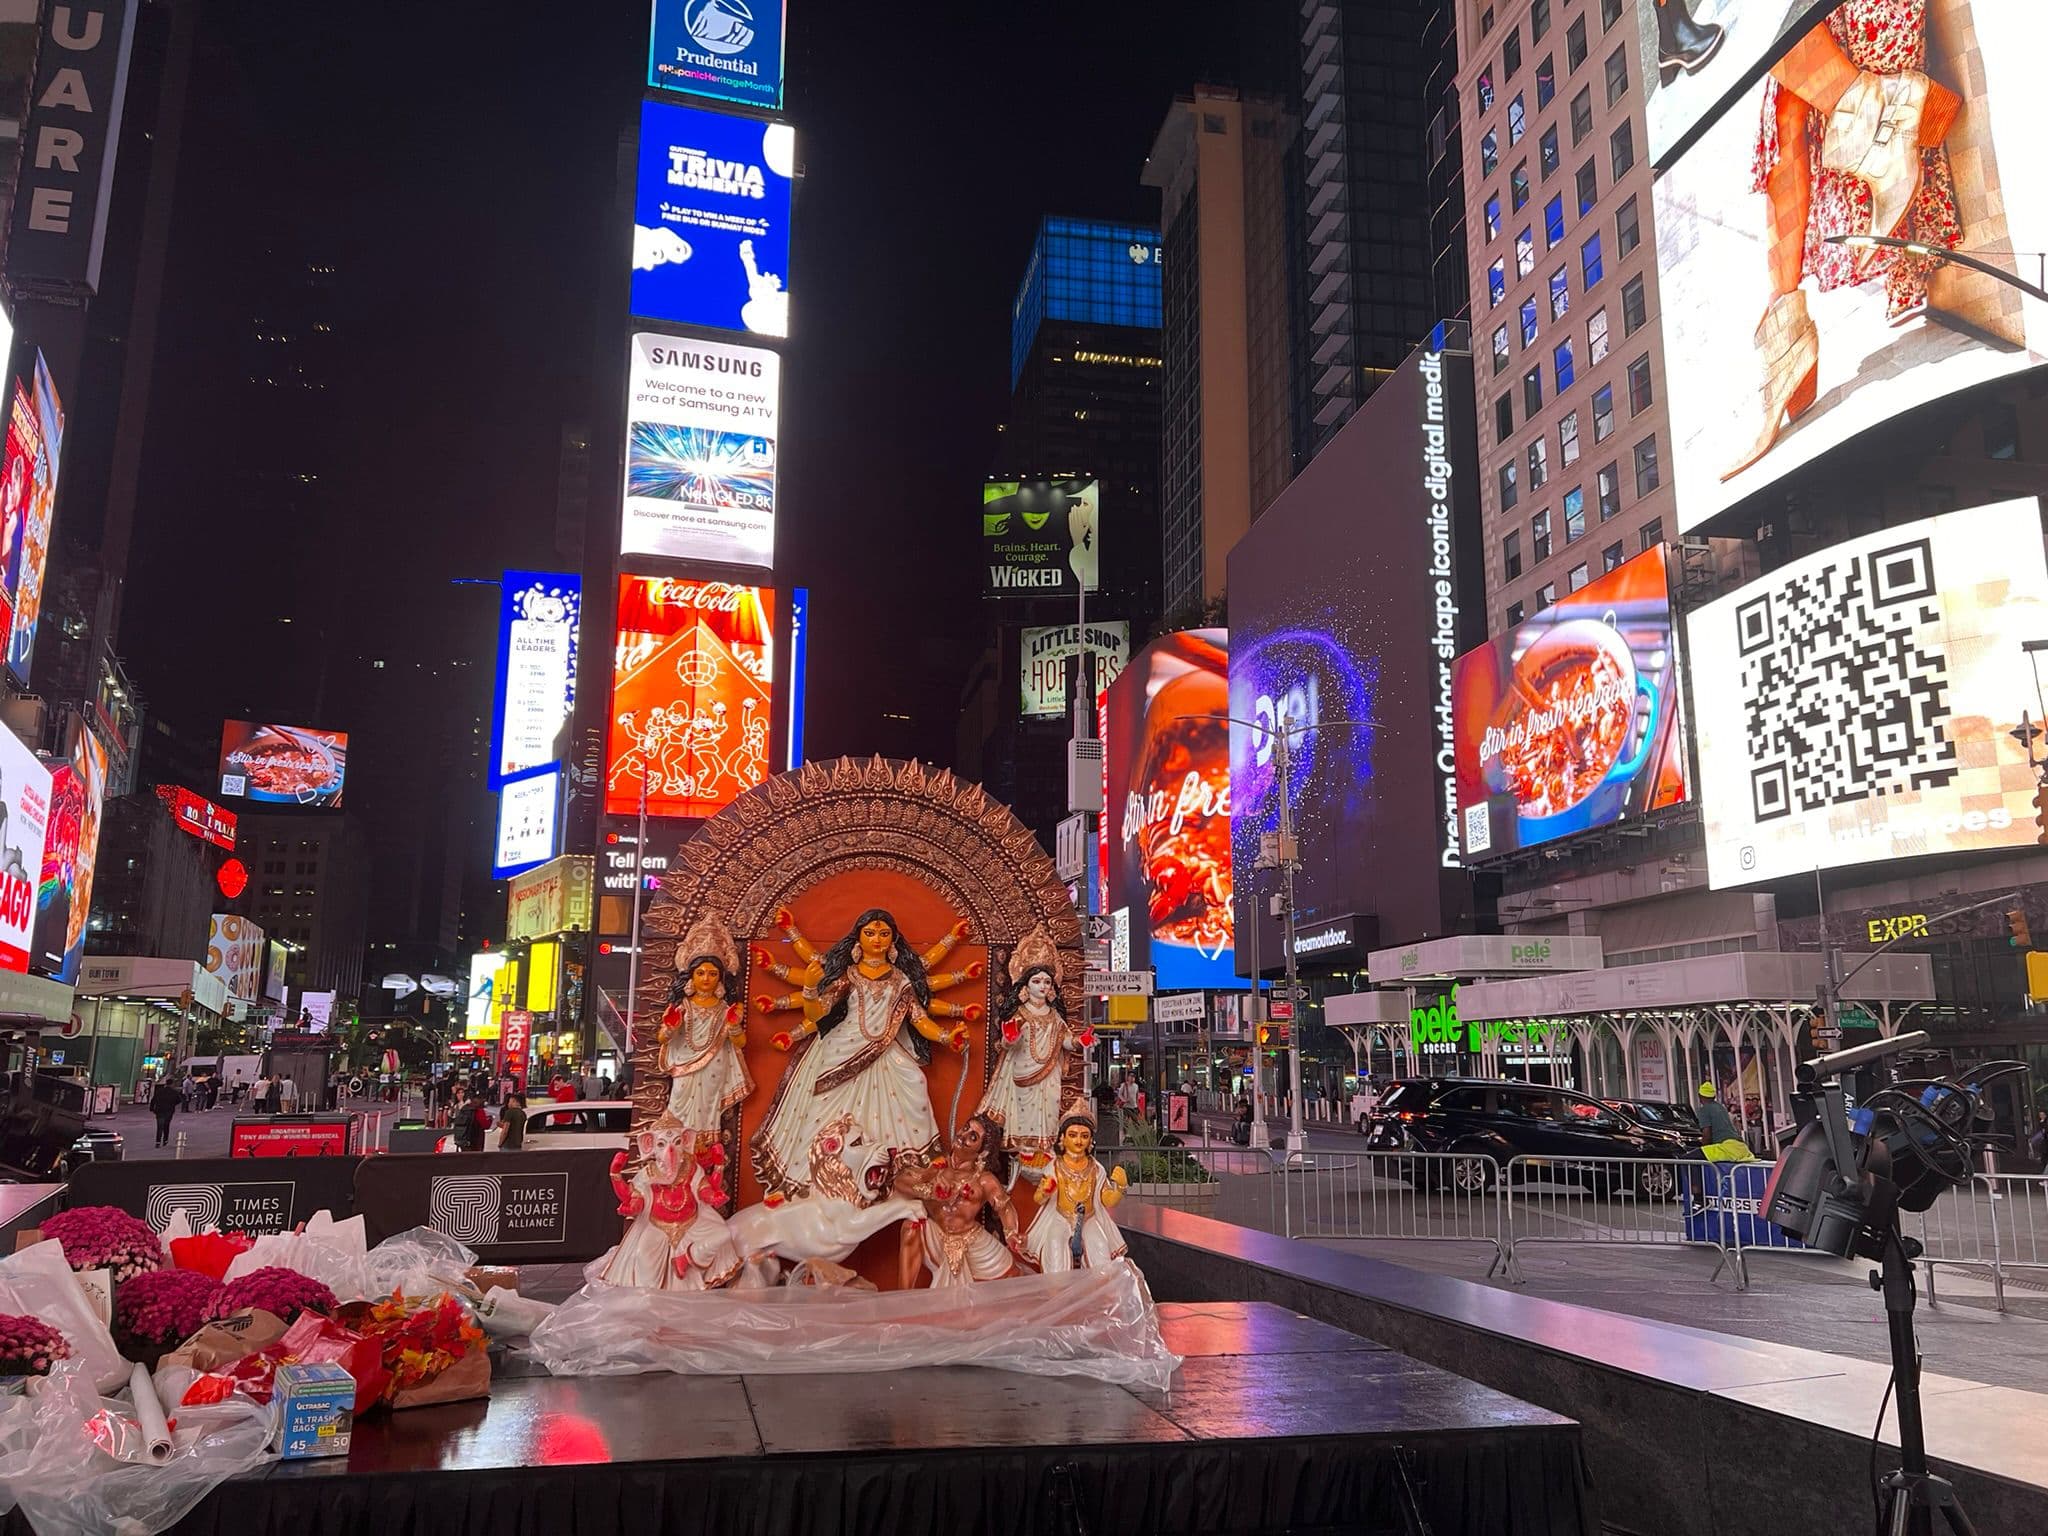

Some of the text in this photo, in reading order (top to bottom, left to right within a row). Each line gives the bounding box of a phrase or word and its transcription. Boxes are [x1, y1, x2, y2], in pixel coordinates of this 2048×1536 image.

[676, 47, 758, 76] Prudential
[668, 151, 765, 186] TRIVIA
[667, 169, 765, 199] MOMENTS
[652, 347, 762, 378] SAMSUNG
[645, 379, 765, 404] Welcome to a new
[637, 393, 773, 418] era of Samsung AI TV
[1422, 423, 1453, 500] digital
[715, 491, 754, 506] QLED
[756, 493, 772, 509] 8K
[633, 509, 767, 531] Discover more at samsung.com
[993, 542, 1061, 552] Brains. Heart.
[1427, 503, 1451, 576] iconic
[1005, 552, 1049, 563] Courage.
[1432, 580, 1459, 658] shape
[516, 644, 556, 653] LEADERS
[535, 638, 556, 646] TIME
[1031, 627, 1120, 657] LITTLE SHOP
[1031, 655, 1120, 704] HORS
[1434, 663, 1456, 773] Outdoor
[1480, 726, 1507, 767] Stir
[1509, 721, 1524, 747] in
[1122, 789, 1148, 851] Stir
[1147, 785, 1170, 824] in
[1442, 777, 1460, 868] Dream
[606, 852, 635, 868] Tell
[604, 873, 640, 888] with
[1112, 973, 1127, 981] FLOW
[1127, 973, 1142, 982] ZONE
[507, 1013, 527, 1051] tkts
[1423, 1043, 1457, 1053] SOCCER
[232, 1197, 280, 1211] TIMES
[511, 1188, 555, 1202] TIMES
[505, 1202, 559, 1217] SQUARE
[226, 1211, 283, 1227] SQUARE
[508, 1217, 555, 1229] ALLIANCE
[237, 1228, 279, 1237] IANCE
[292, 1424, 316, 1433] BAGS
[294, 1415, 336, 1424] XL TRASH
[290, 1437, 348, 1450] 45 50
